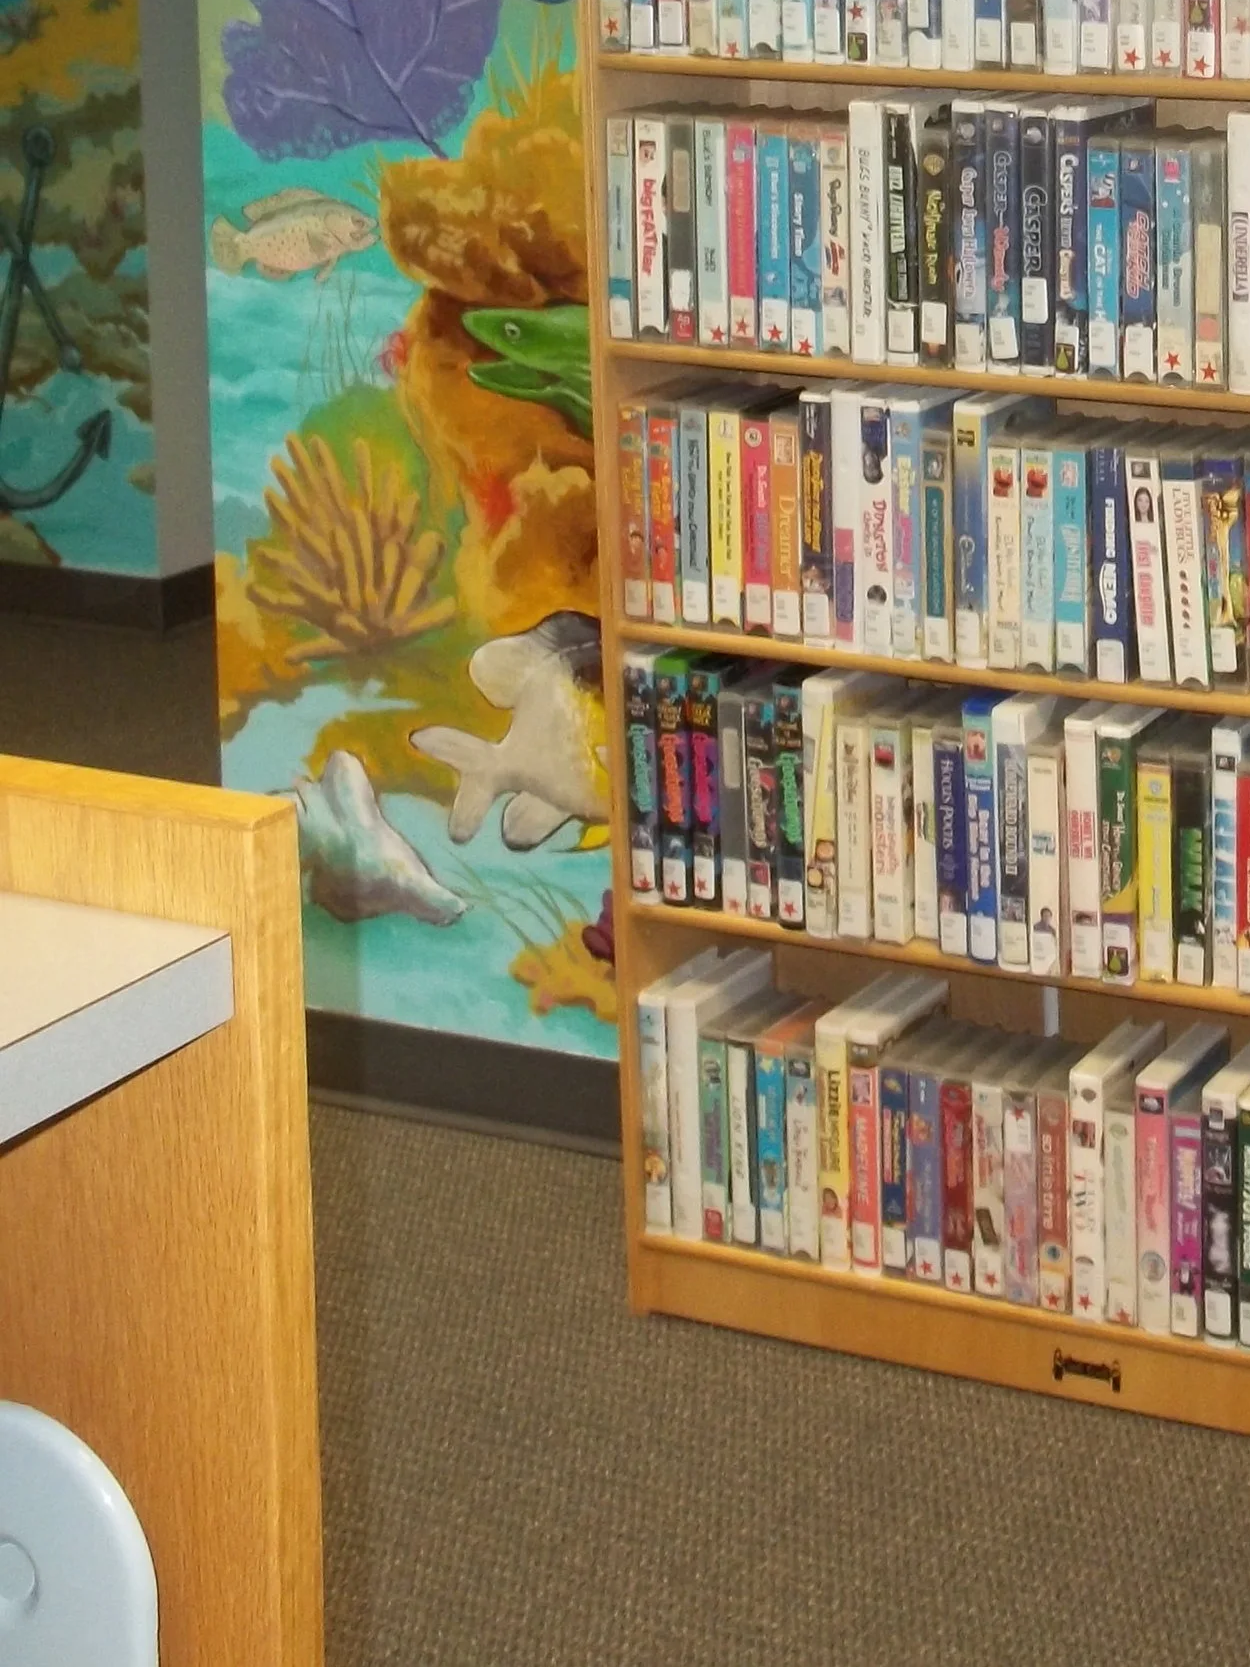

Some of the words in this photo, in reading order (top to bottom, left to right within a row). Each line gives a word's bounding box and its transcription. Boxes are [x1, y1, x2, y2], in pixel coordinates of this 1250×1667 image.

[642, 178, 659, 206] big
[858, 147, 871, 182] BUGS
[992, 150, 1012, 219] CASPER
[1058, 153, 1079, 215] CASPER'S
[642, 208, 659, 246] FAT
[793, 193, 804, 224] Story
[889, 192, 905, 254] LIGHTYEAR
[1022, 185, 1049, 273] CASPER
[794, 227, 804, 257] Time
[1094, 243, 1106, 275] CAT
[1137, 212, 1151, 291] CATCH
[1232, 216, 1249, 294] CINDERELLA
[1104, 497, 1116, 558] FINDING
[1171, 487, 1185, 564] LADYBUGS
[1181, 490, 1193, 516] FIVE
[778, 494, 797, 581] Dreamer
[872, 498, 889, 574] DUNSTON
[1183, 520, 1195, 560] LITTLE
[1099, 562, 1118, 626] NEMO
[628, 723, 654, 814] Goosebumps
[657, 732, 685, 823] Goosebumps
[691, 732, 713, 823] Goosebumps
[775, 751, 803, 845] Goosebumps
[939, 758, 955, 804] HOCUS
[747, 755, 769, 849] Goosebumps
[939, 804, 955, 850] POCUS
[978, 809, 989, 844] Bear
[1214, 799, 1235, 856] ICE
[873, 794, 887, 876] monsters
[1005, 825, 1018, 863] BOUND
[1214, 856, 1235, 923] AGE
[827, 1069, 842, 1117] Lizzie
[1042, 1133, 1053, 1154] so
[1042, 1155, 1056, 1191] little
[1042, 1192, 1056, 1230] time
